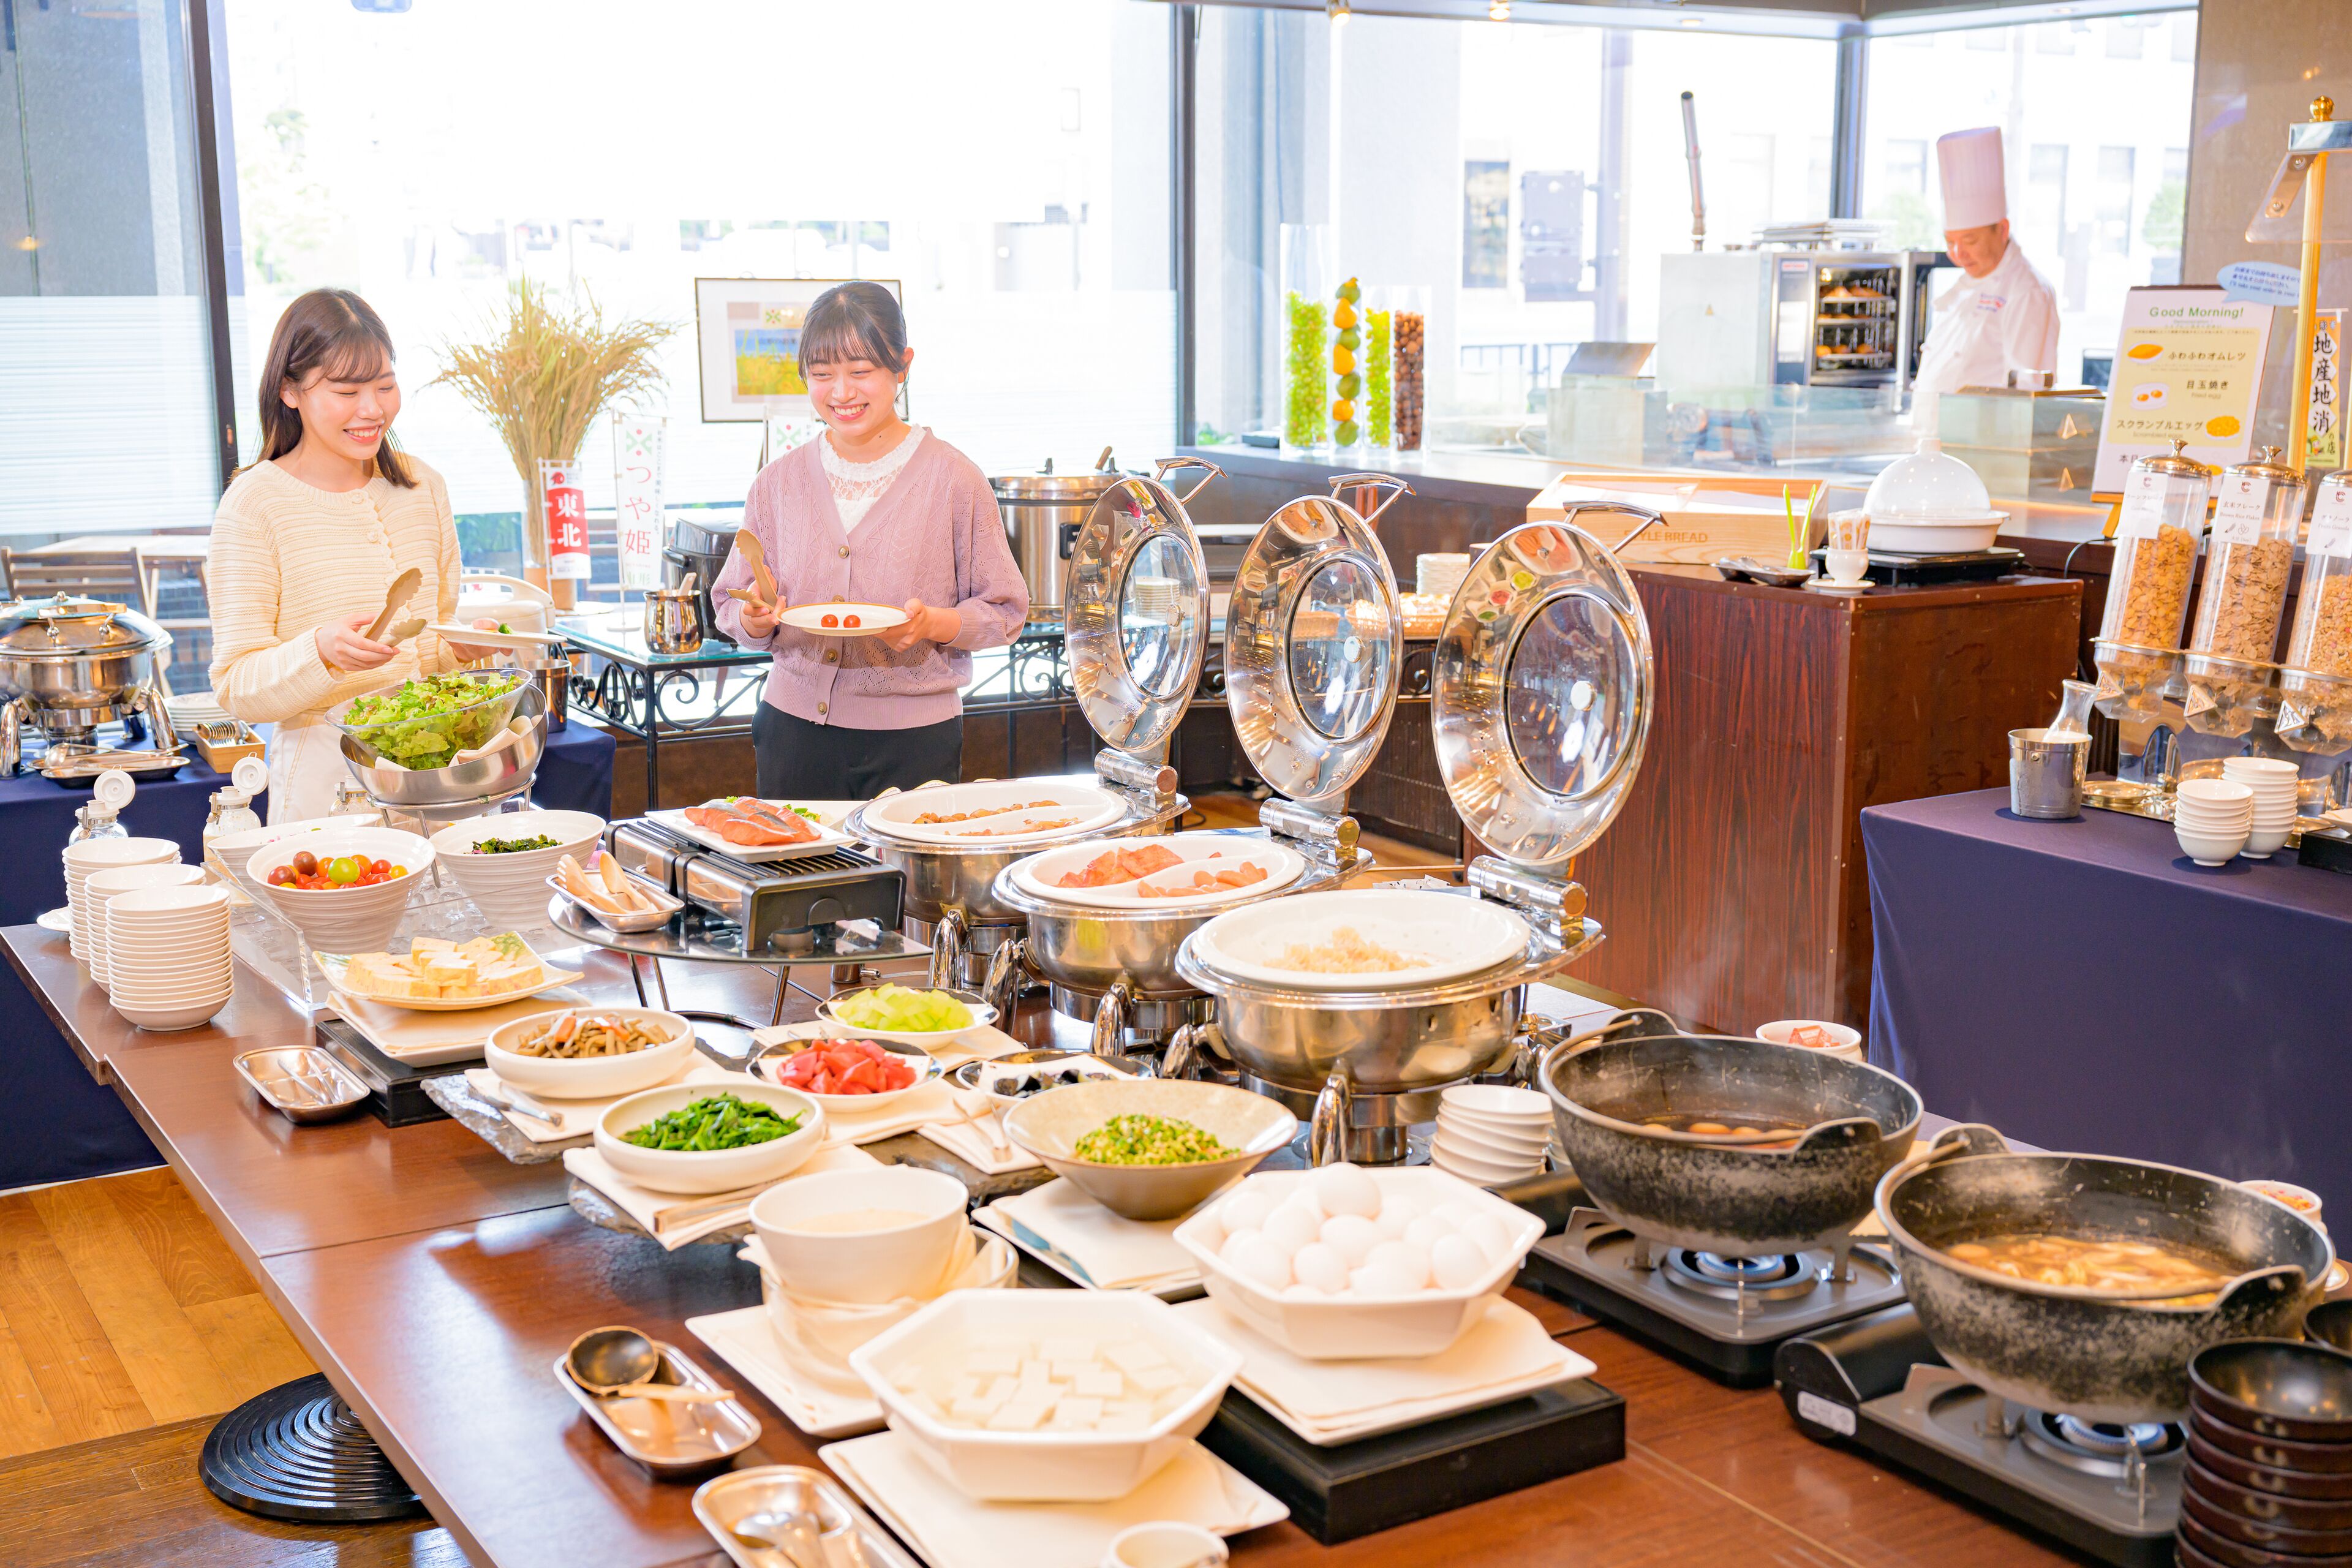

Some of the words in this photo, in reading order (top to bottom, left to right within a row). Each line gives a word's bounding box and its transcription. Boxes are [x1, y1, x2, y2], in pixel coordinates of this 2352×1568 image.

[2149, 307, 2184, 317] Good
[2188, 307, 2244, 319] Morning!
[2168, 352, 2246, 361] ふわふわオムレツ
[2187, 380, 2229, 390] 目玉焼き
[2117, 419, 2204, 430] スクランブルエッグ
[625, 466, 652, 555] つや姫
[2223, 501, 2261, 510] 玄米フレーク
[555, 493, 582, 547] 東北
[1624, 530, 1662, 541] YLE
[1664, 532, 1708, 543] BREAD
